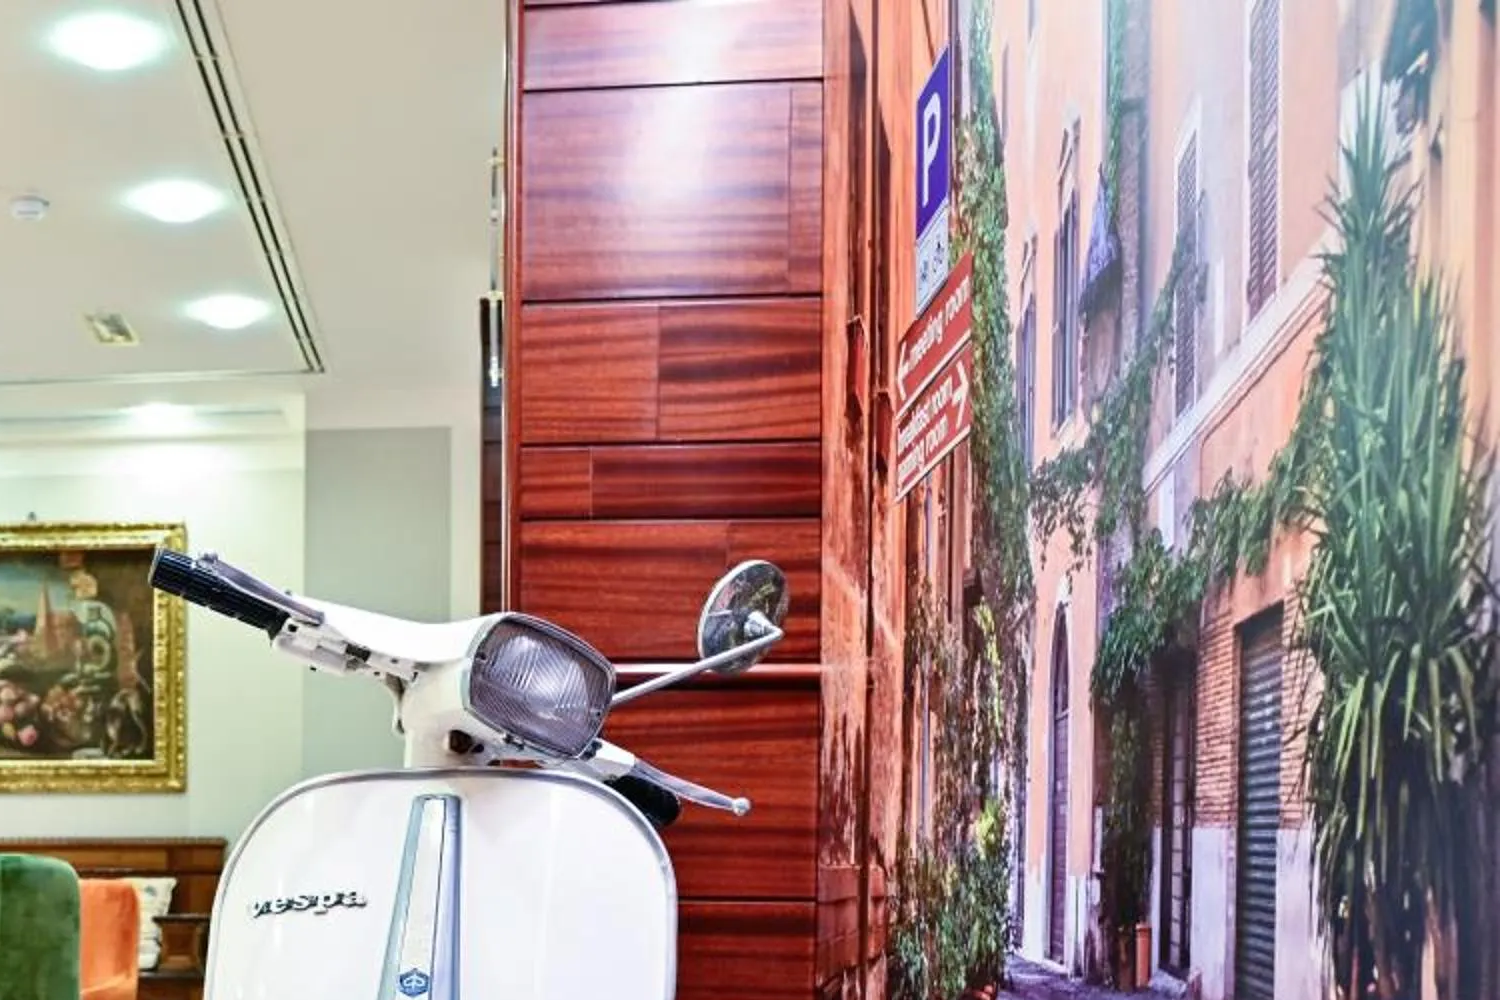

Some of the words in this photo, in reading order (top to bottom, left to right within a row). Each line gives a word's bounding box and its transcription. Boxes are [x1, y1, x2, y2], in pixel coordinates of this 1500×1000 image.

[923, 92, 941, 207] P
[910, 312, 942, 364] meeting
[945, 276, 970, 324] room
[931, 375, 953, 414] room
[926, 413, 948, 456] room
